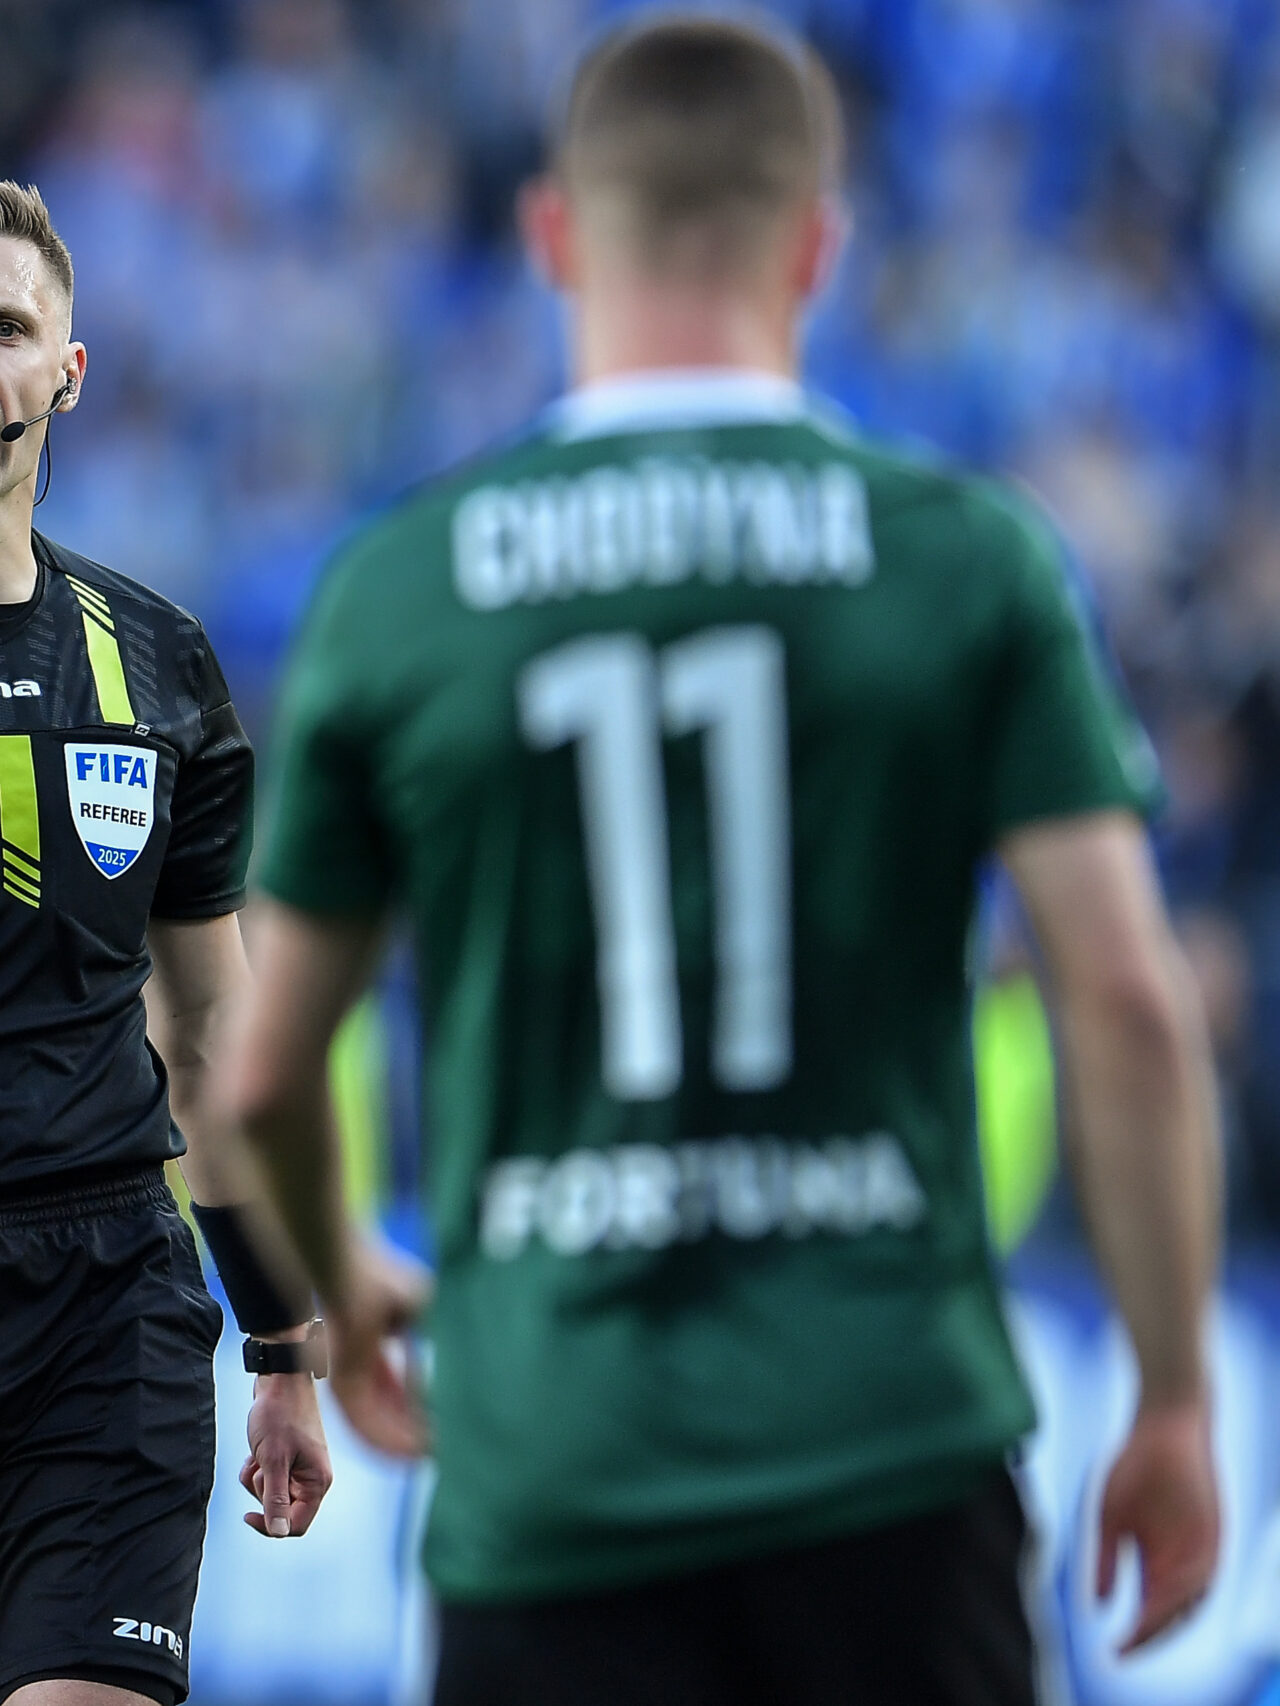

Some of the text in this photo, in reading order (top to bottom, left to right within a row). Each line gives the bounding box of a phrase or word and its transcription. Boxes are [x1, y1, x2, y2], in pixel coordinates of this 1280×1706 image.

[75, 752, 148, 789] FIFA
[80, 802, 147, 828] REFEREE
[97, 848, 127, 867] 2025
[521, 625, 790, 1100] 11
[480, 1133, 923, 1261] FORTUNA
